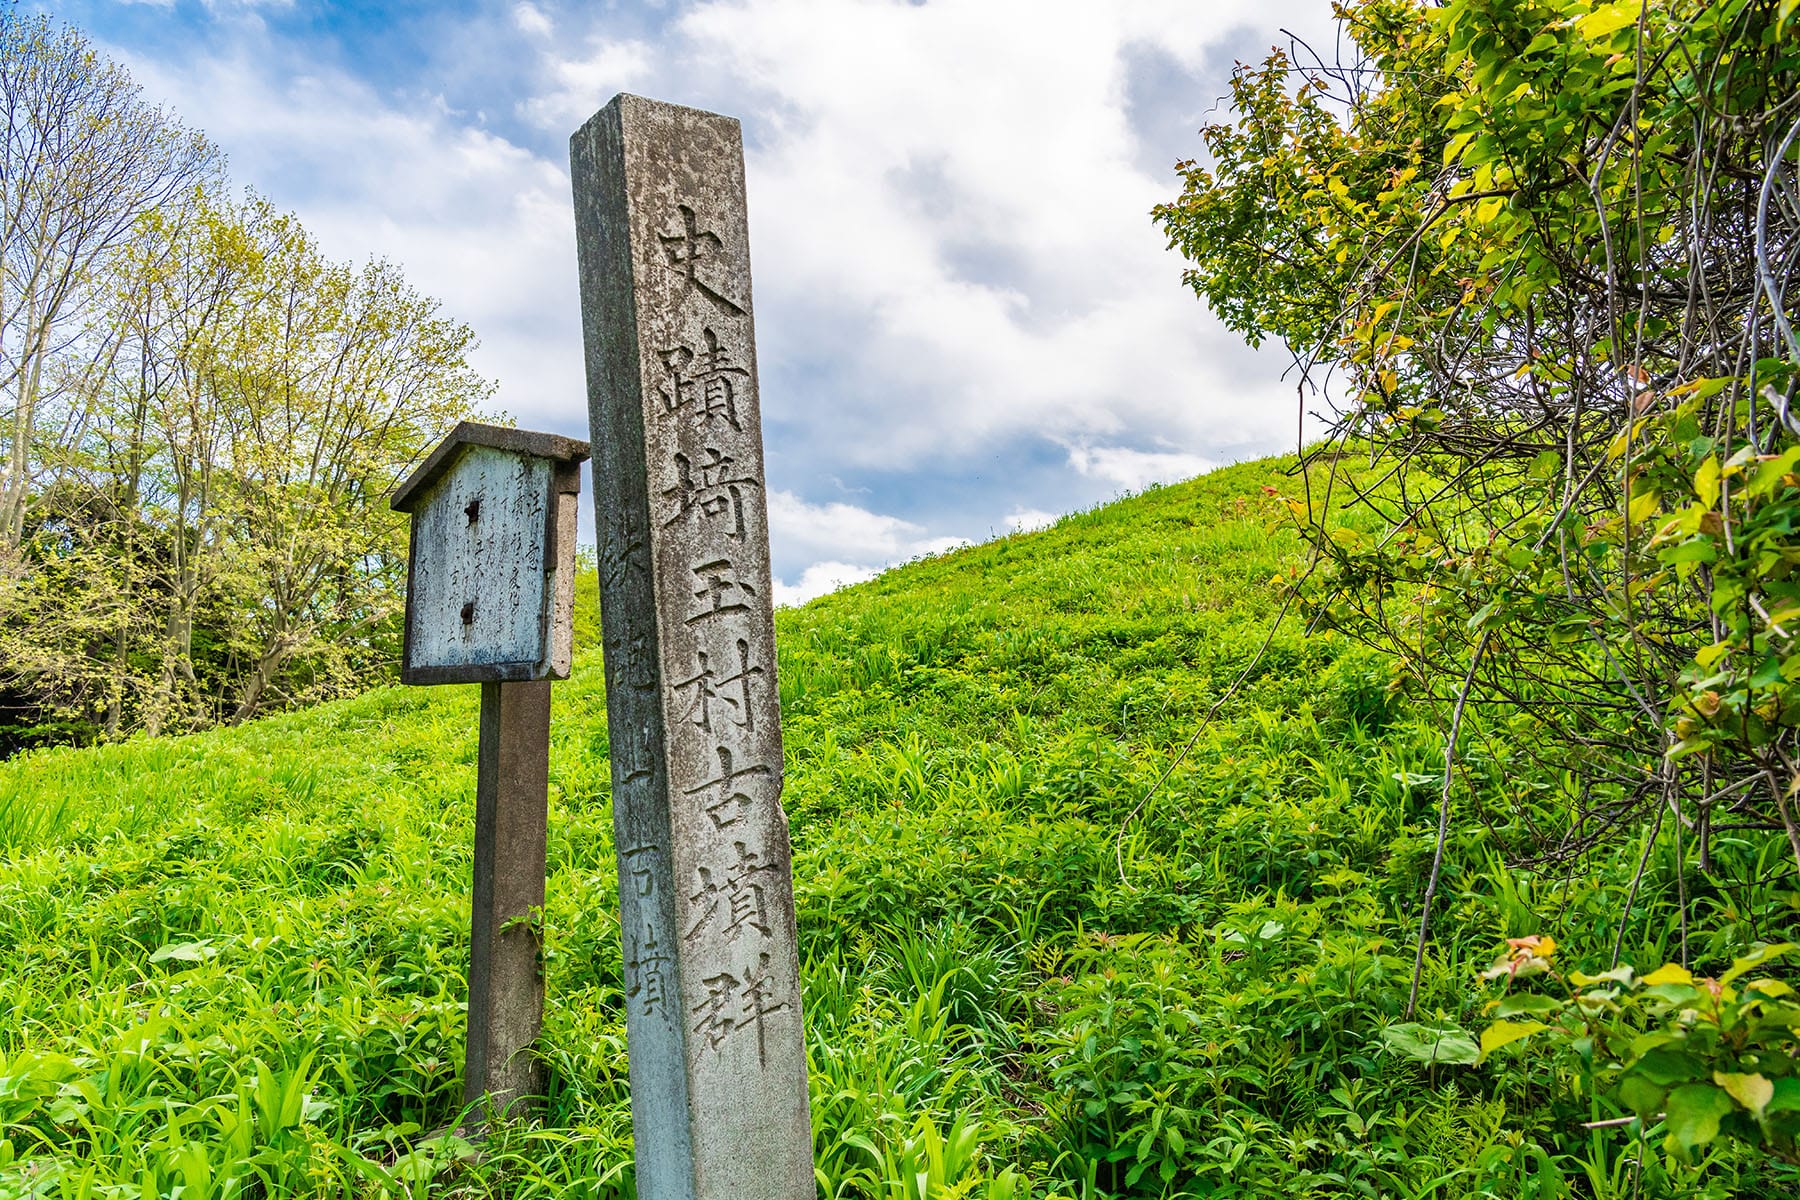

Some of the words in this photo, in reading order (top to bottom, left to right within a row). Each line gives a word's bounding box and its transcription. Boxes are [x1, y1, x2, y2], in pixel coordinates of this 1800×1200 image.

[657, 204, 793, 1071] 史蹟埼玉村古墳群
